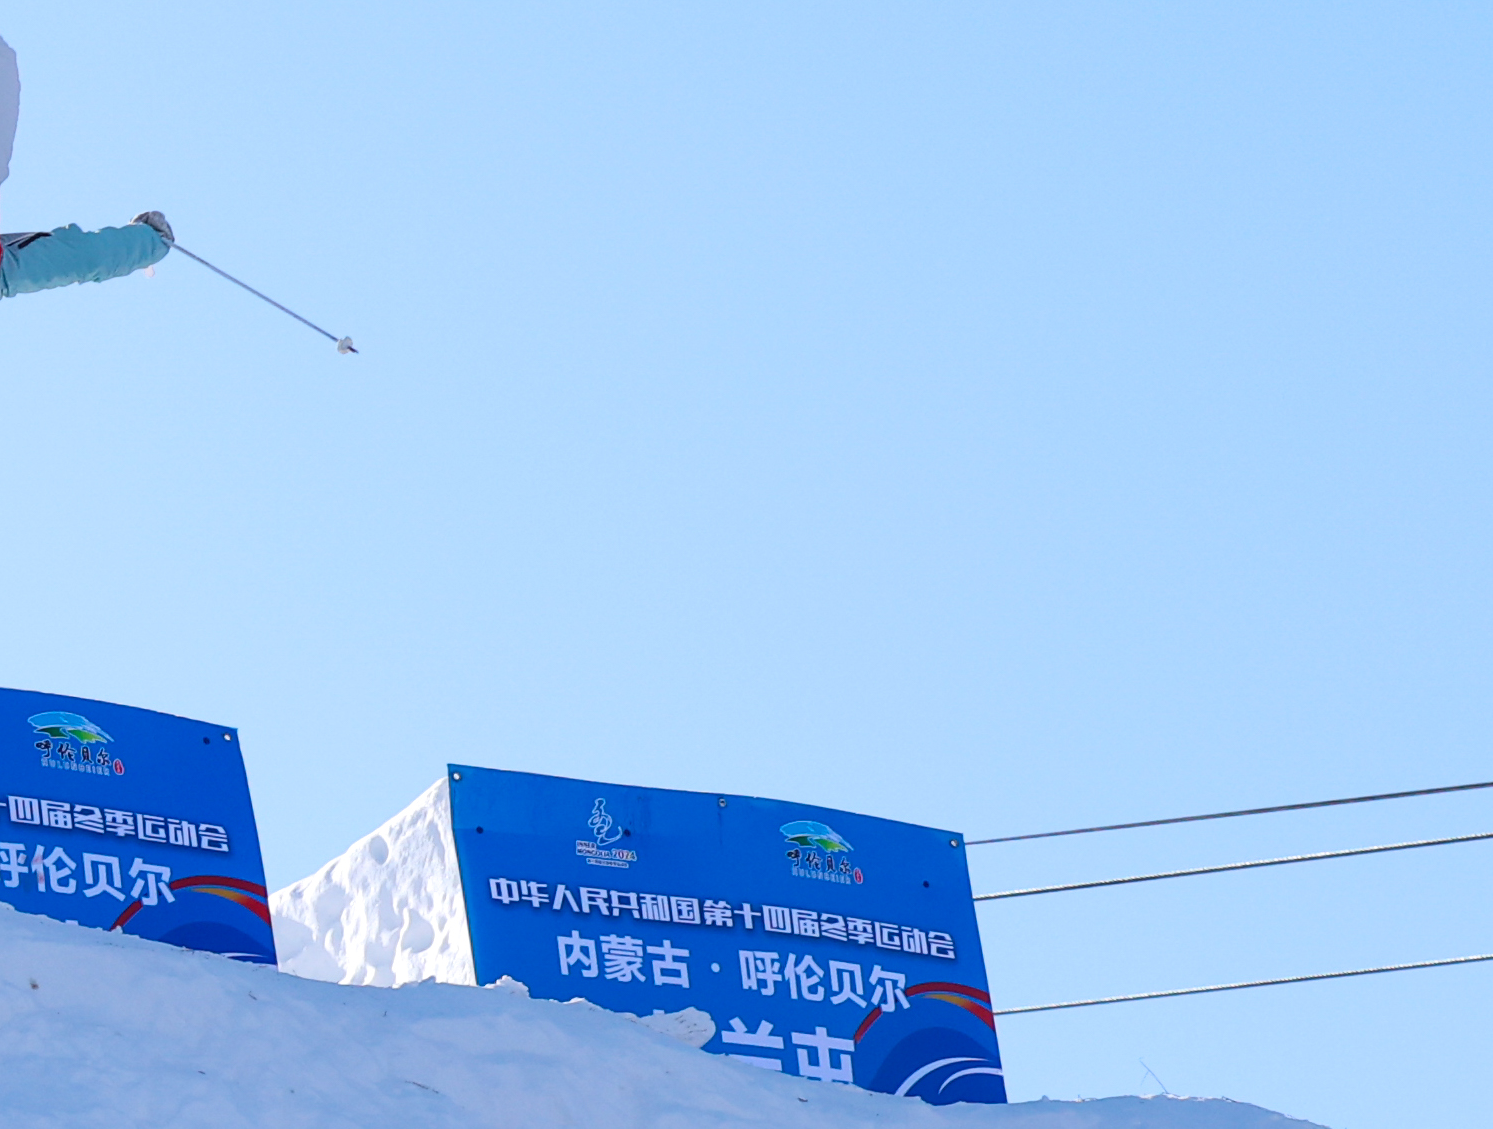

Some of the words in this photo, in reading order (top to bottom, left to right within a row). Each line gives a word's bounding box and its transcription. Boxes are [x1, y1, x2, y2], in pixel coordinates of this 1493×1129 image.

[611, 848, 637, 861] 2024
[489, 877, 956, 959] 中华人民共和国第十四届冬季运动会
